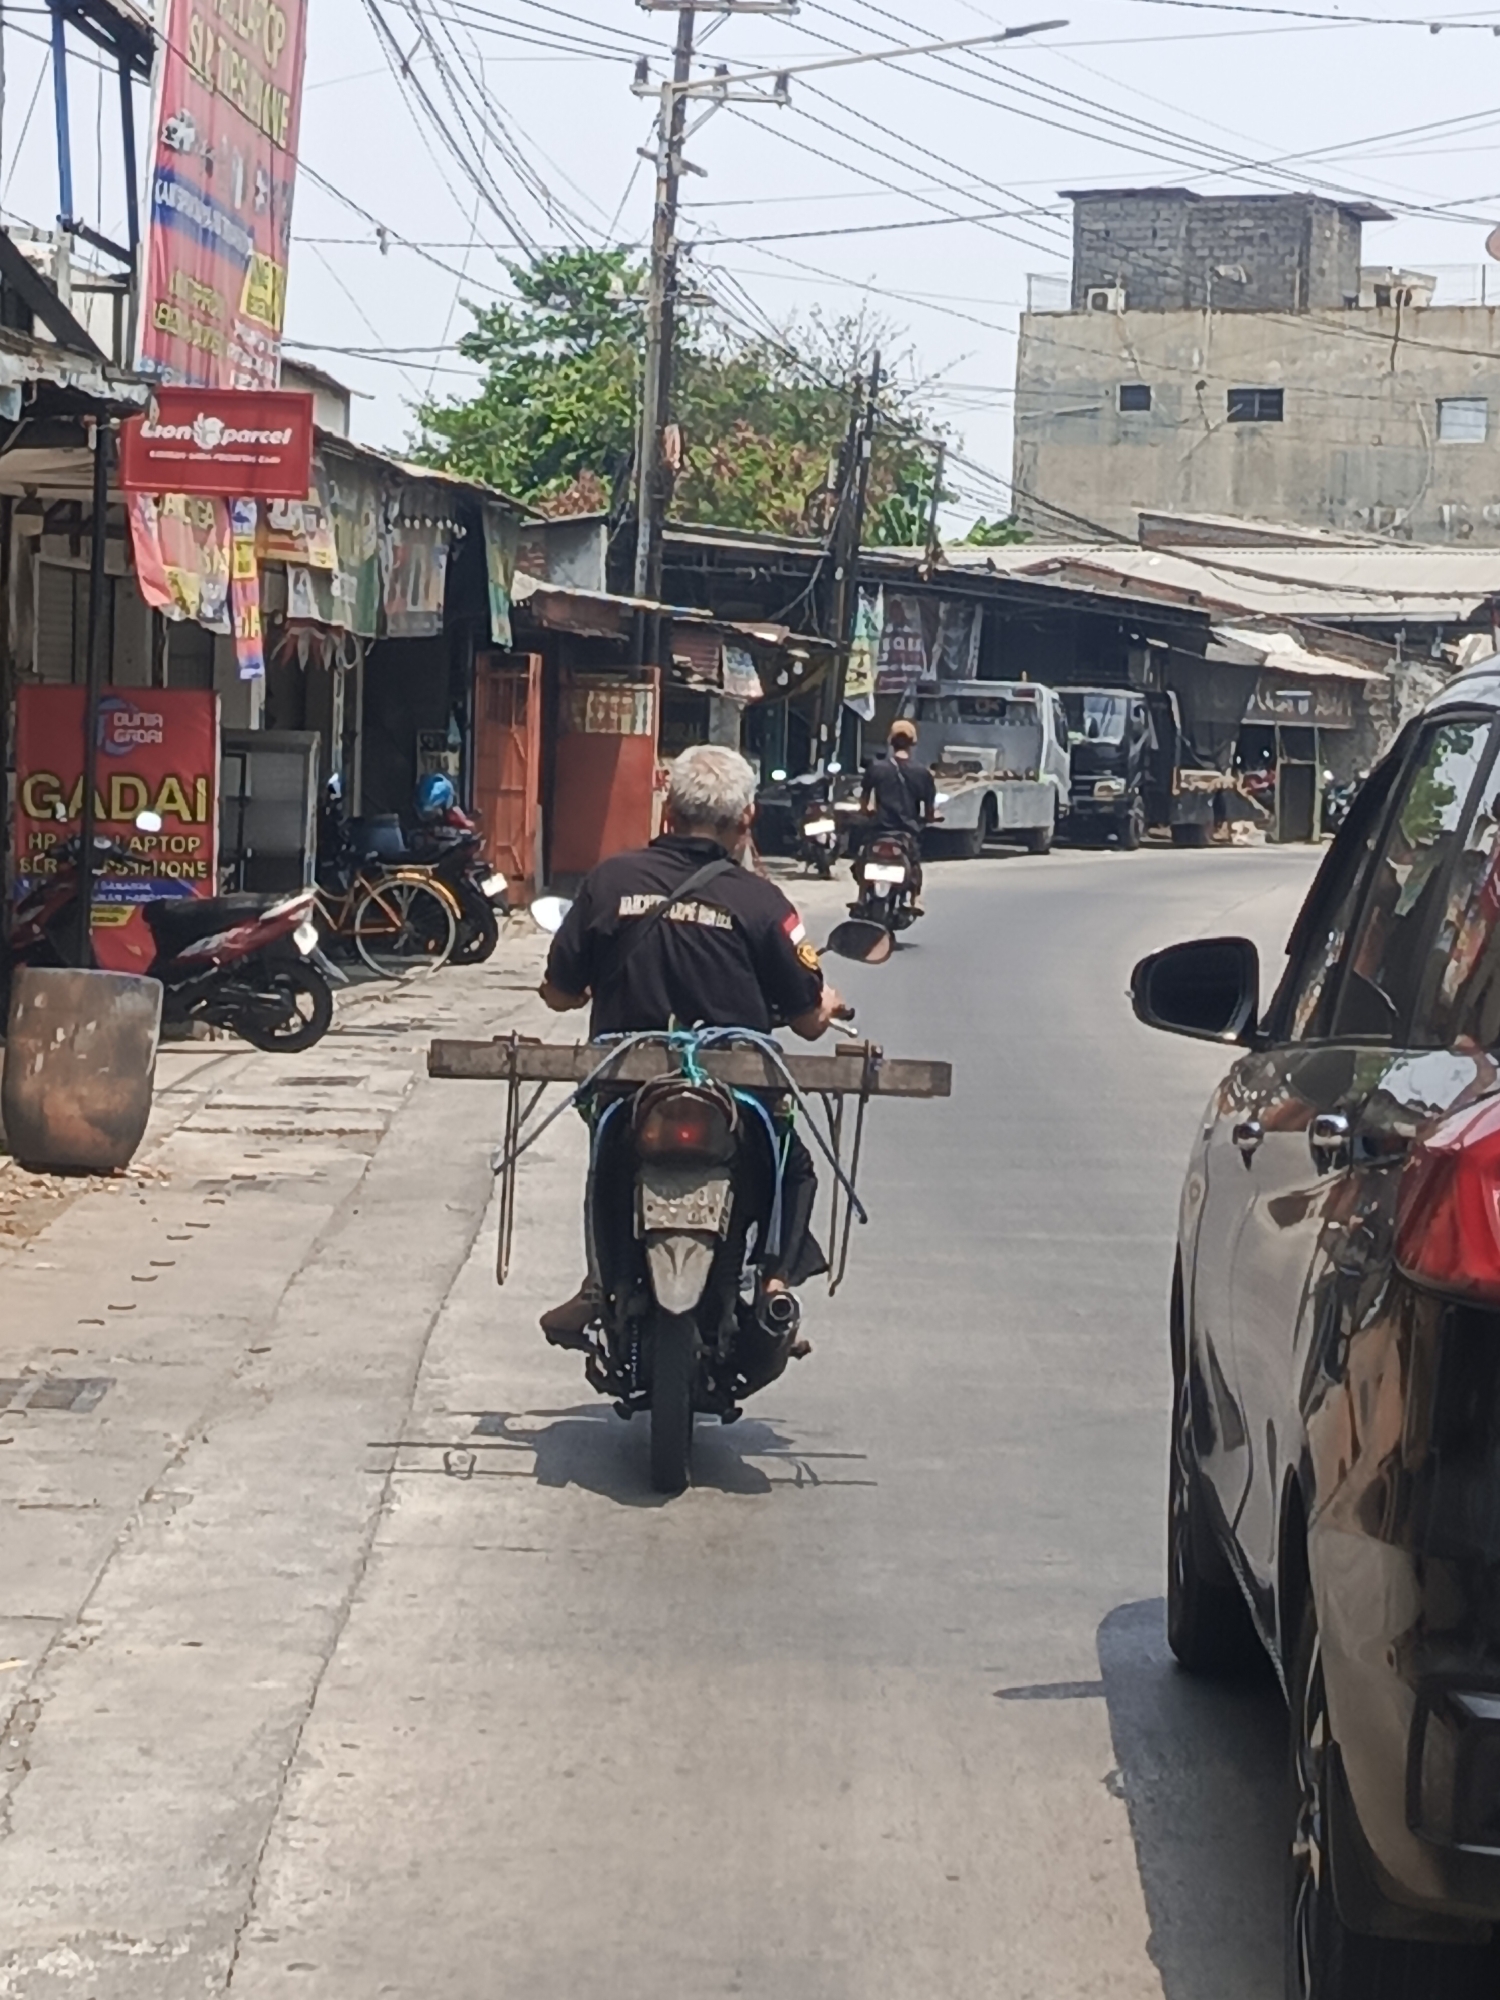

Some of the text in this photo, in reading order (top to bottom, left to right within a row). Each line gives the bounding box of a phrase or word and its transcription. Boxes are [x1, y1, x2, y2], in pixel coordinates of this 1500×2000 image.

[140, 420, 293, 447] Lion parcel
[113, 712, 163, 727] DUNIA
[113, 729, 163, 743] GADAI
[22, 772, 206, 822] GADAI
[28, 832, 57, 850] HP
